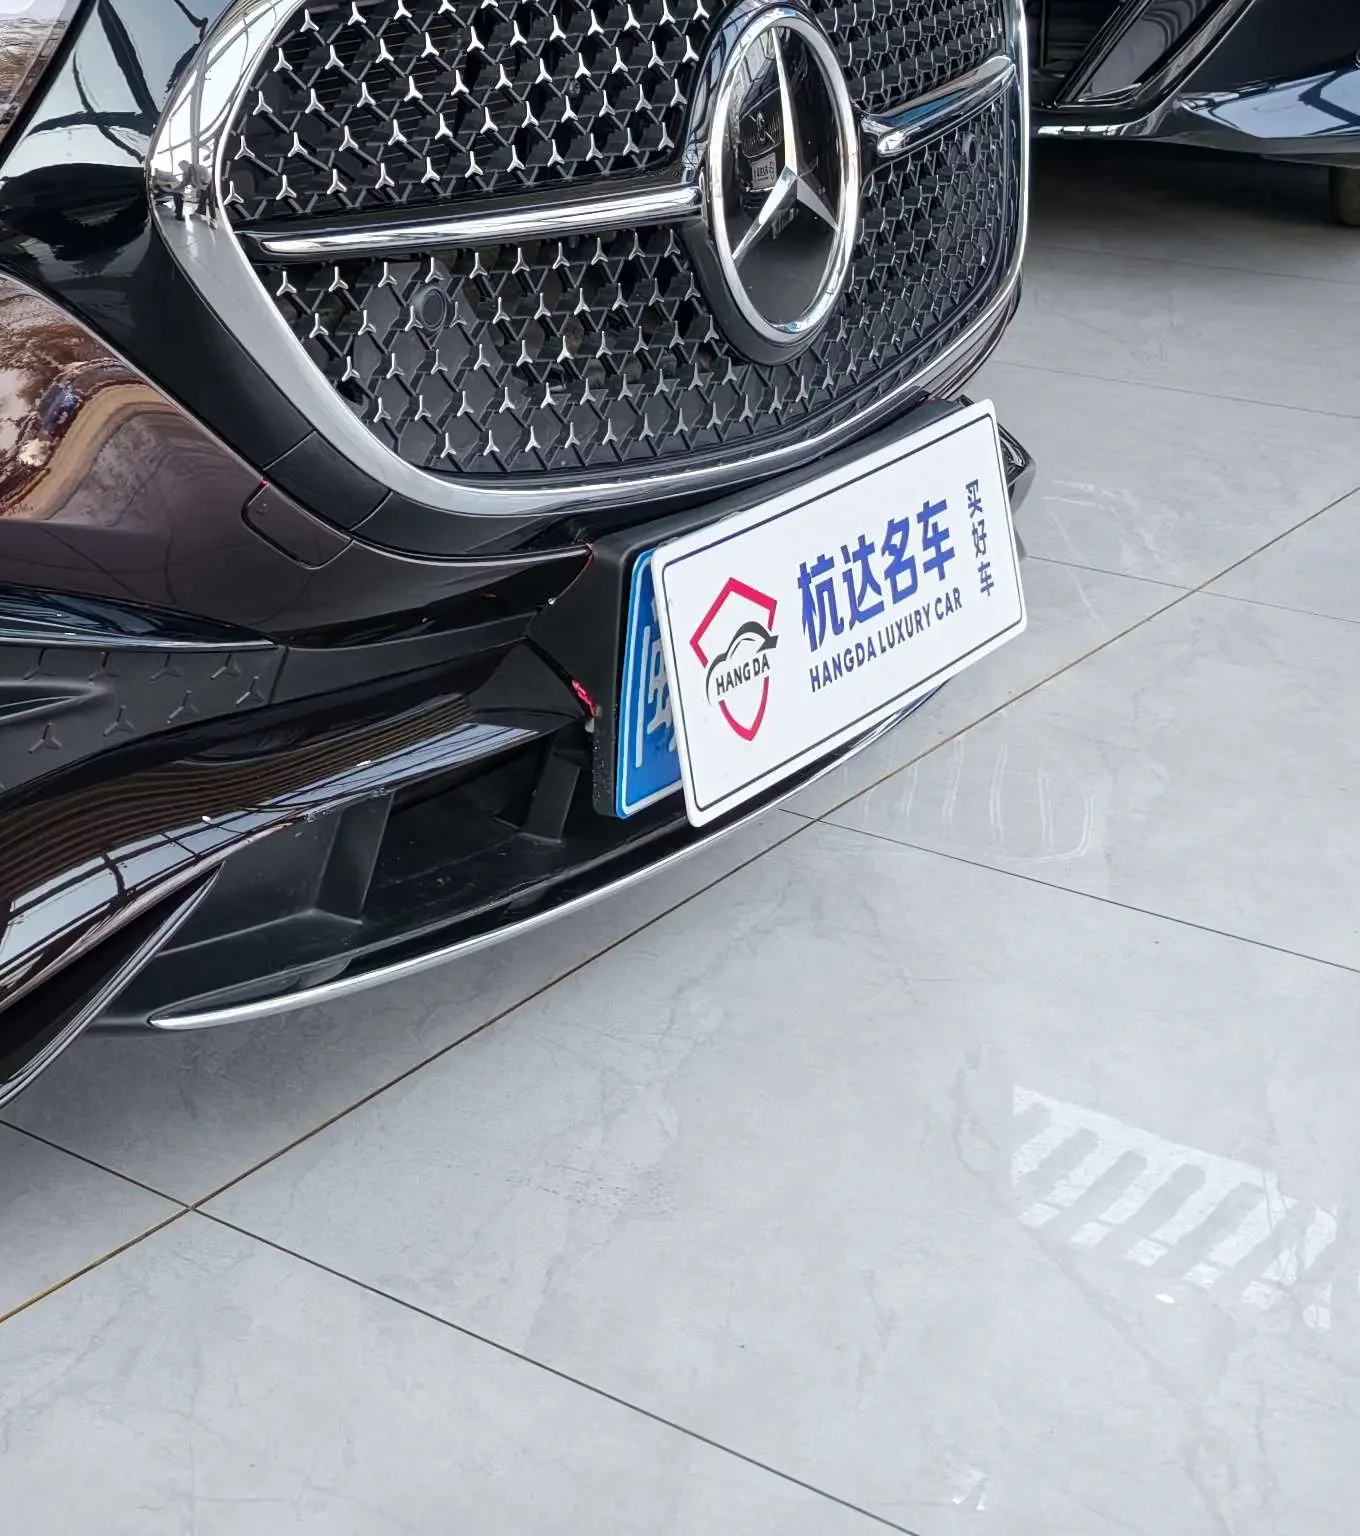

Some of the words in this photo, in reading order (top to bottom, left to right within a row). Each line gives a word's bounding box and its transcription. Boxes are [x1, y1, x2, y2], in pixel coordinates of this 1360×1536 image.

[796, 497, 957, 654] 杭达名车
[965, 478, 995, 598] 买好车
[715, 662, 752, 697] HANG
[752, 652, 771, 678] DA
[809, 636, 878, 693] HANGDA
[879, 601, 933, 656] LUXURY
[934, 586, 963, 622] CAR
